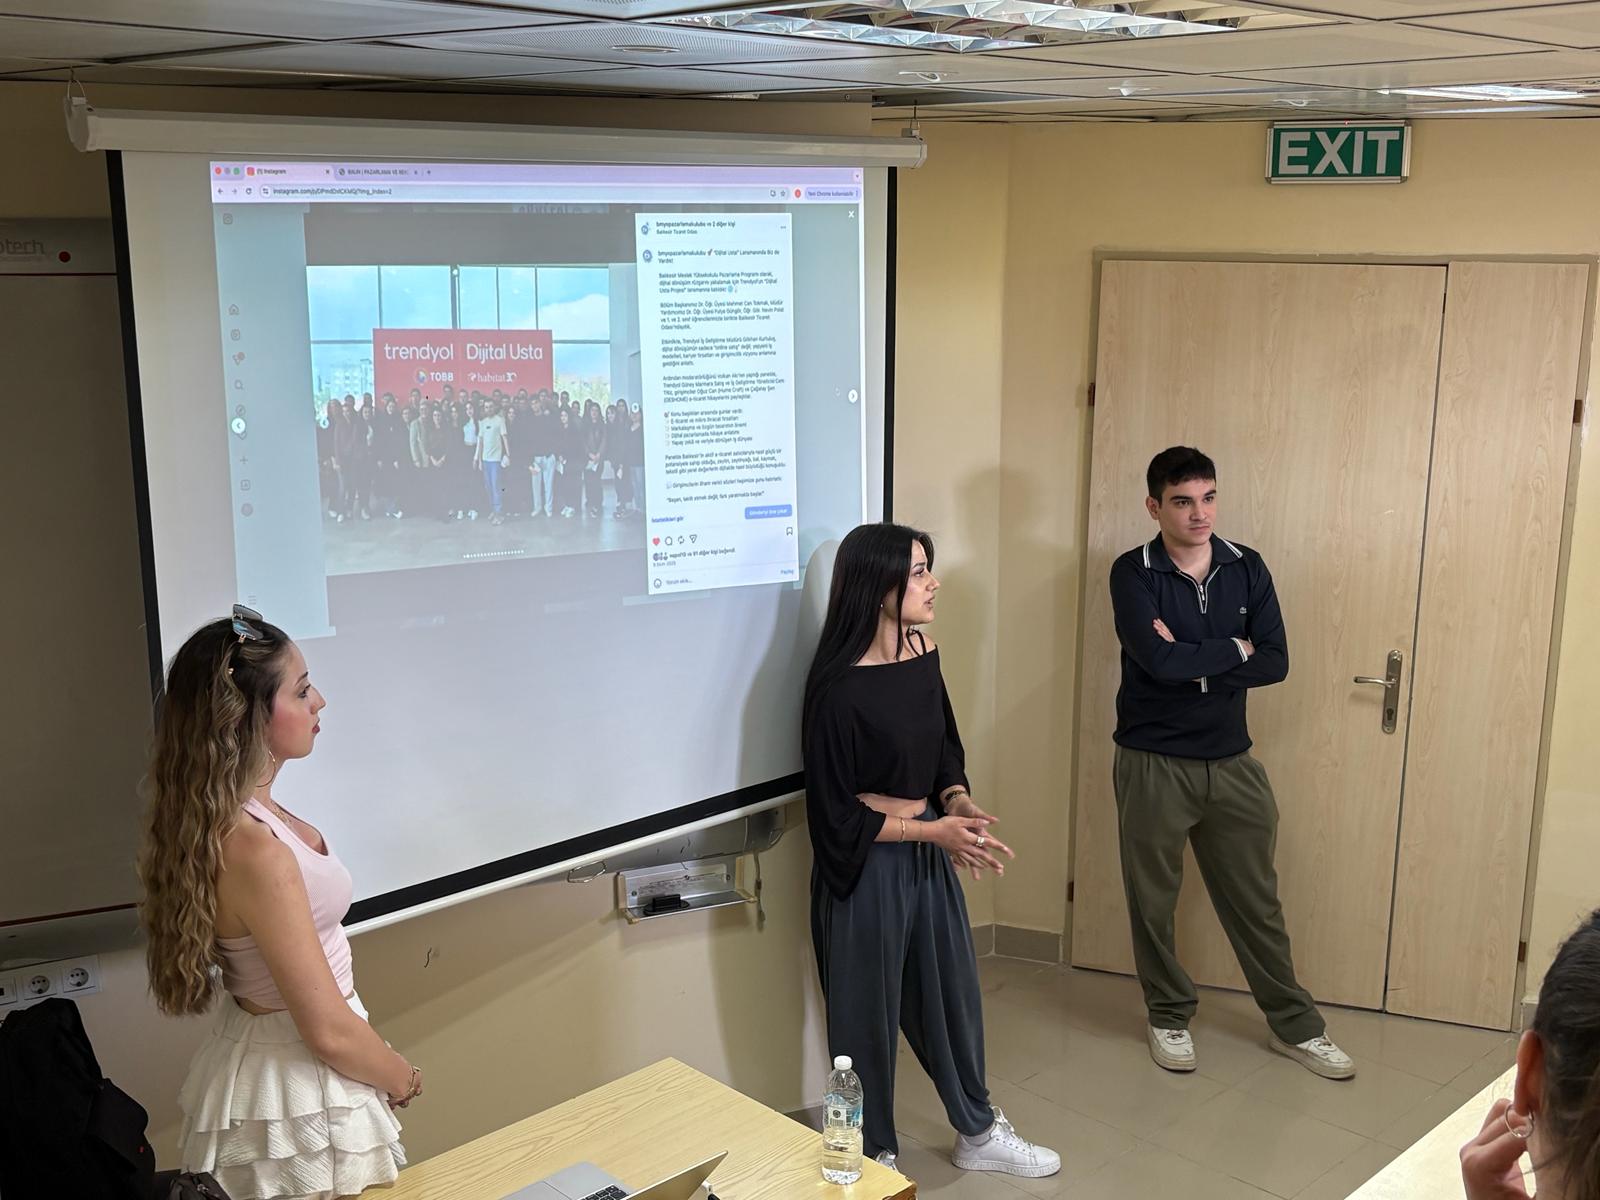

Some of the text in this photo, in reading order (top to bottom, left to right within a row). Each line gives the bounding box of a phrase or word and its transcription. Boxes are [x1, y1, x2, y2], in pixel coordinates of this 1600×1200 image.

[1278, 130, 1400, 175] EXIT
[384, 343, 454, 363] trendyol
[466, 343, 543, 364] Dijital Usta
[430, 372, 454, 382] TOBB
